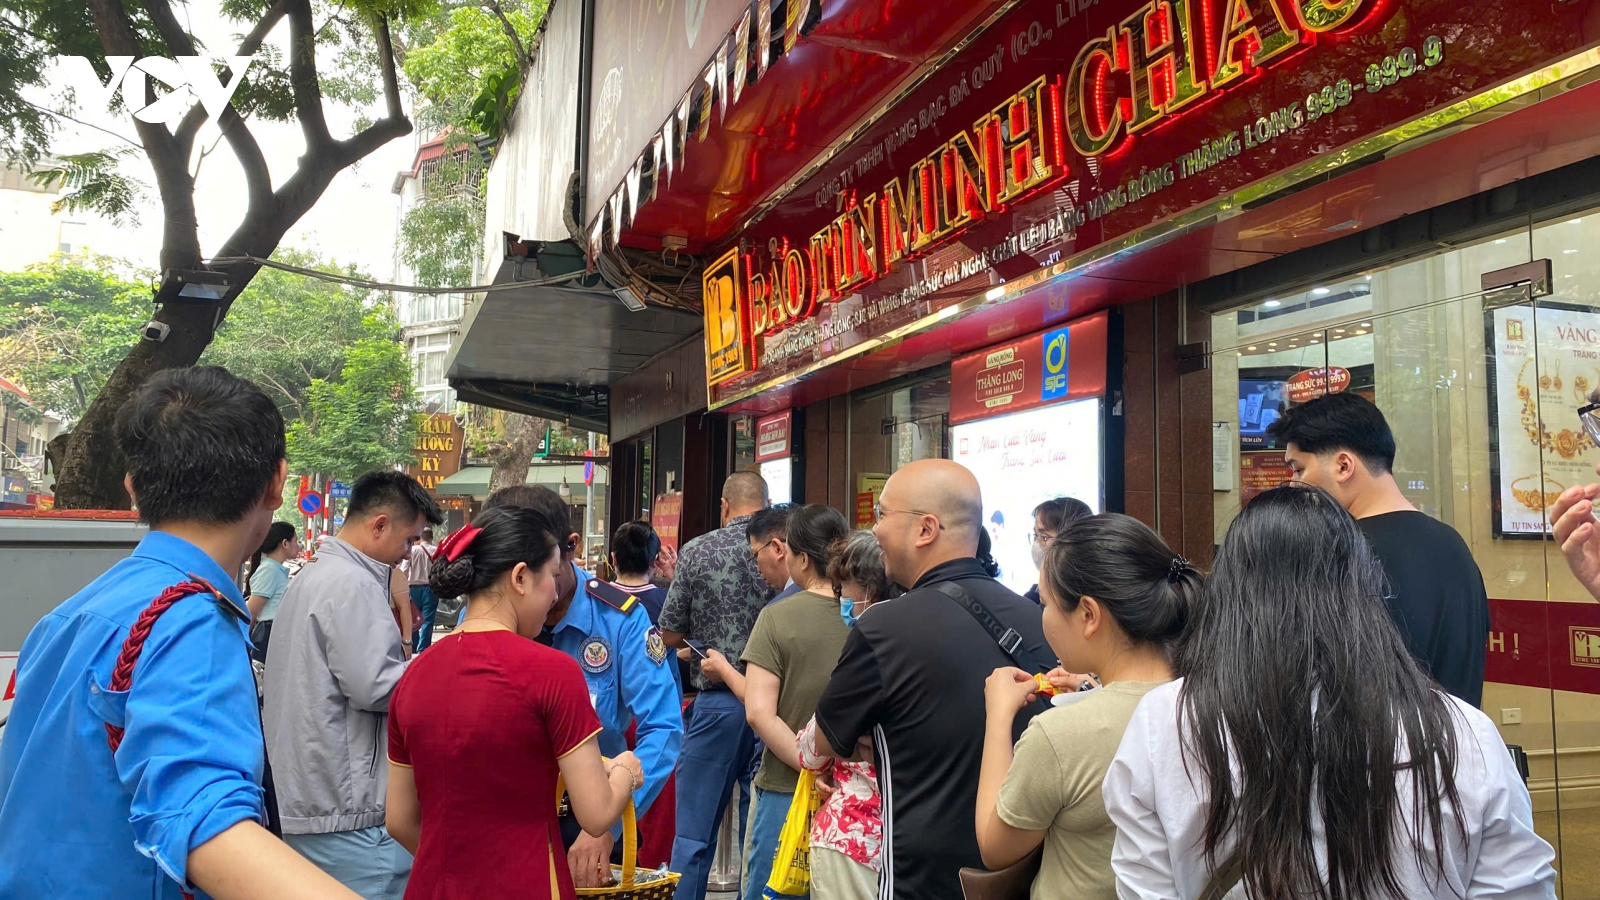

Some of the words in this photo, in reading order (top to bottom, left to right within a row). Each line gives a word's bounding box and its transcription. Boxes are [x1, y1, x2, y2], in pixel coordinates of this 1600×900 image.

[840, 167, 854, 188] TY
[855, 142, 884, 177] TNHH
[884, 117, 918, 153] VÀNG
[918, 95, 947, 128] BẠC
[972, 44, 1005, 88] QUÝ
[1086, 184, 1127, 221] VÀNG
[1127, 163, 1175, 203] RỒNG
[1176, 133, 1241, 180] THĂNG
[1243, 101, 1303, 150] LONG
[750, 237, 806, 337] BẢO
[809, 189, 878, 304] TÍN
[883, 75, 1053, 265] MINH
[1557, 322, 1597, 343] VÀNG
[1572, 349, 1598, 359] TRANG
[977, 374, 1001, 391] THĂNG
[1002, 368, 1023, 384] LONG
[1285, 380, 1305, 392] TRANG
[421, 453, 442, 472] KỲ
[1521, 522, 1532, 530] TIN
